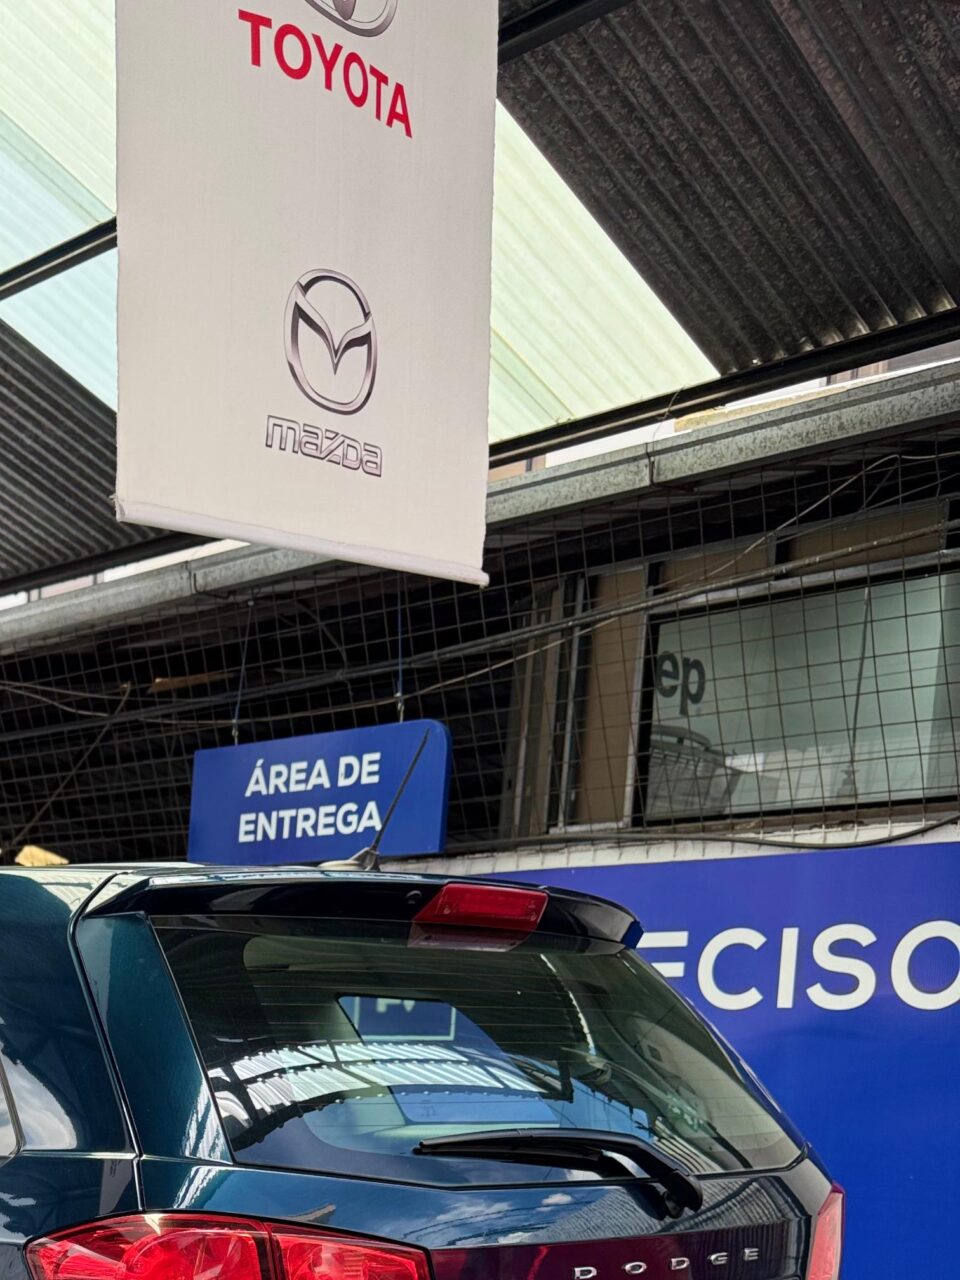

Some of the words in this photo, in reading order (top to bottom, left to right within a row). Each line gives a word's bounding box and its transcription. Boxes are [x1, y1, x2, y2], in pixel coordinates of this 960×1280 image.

[238, 9, 413, 139] TOYOTA
[265, 415, 383, 478] mazda
[244, 759, 331, 798] ÁREA
[337, 752, 382, 788] DE
[238, 801, 383, 844] ENTREGA
[575, 1248, 759, 1280] DODGE
